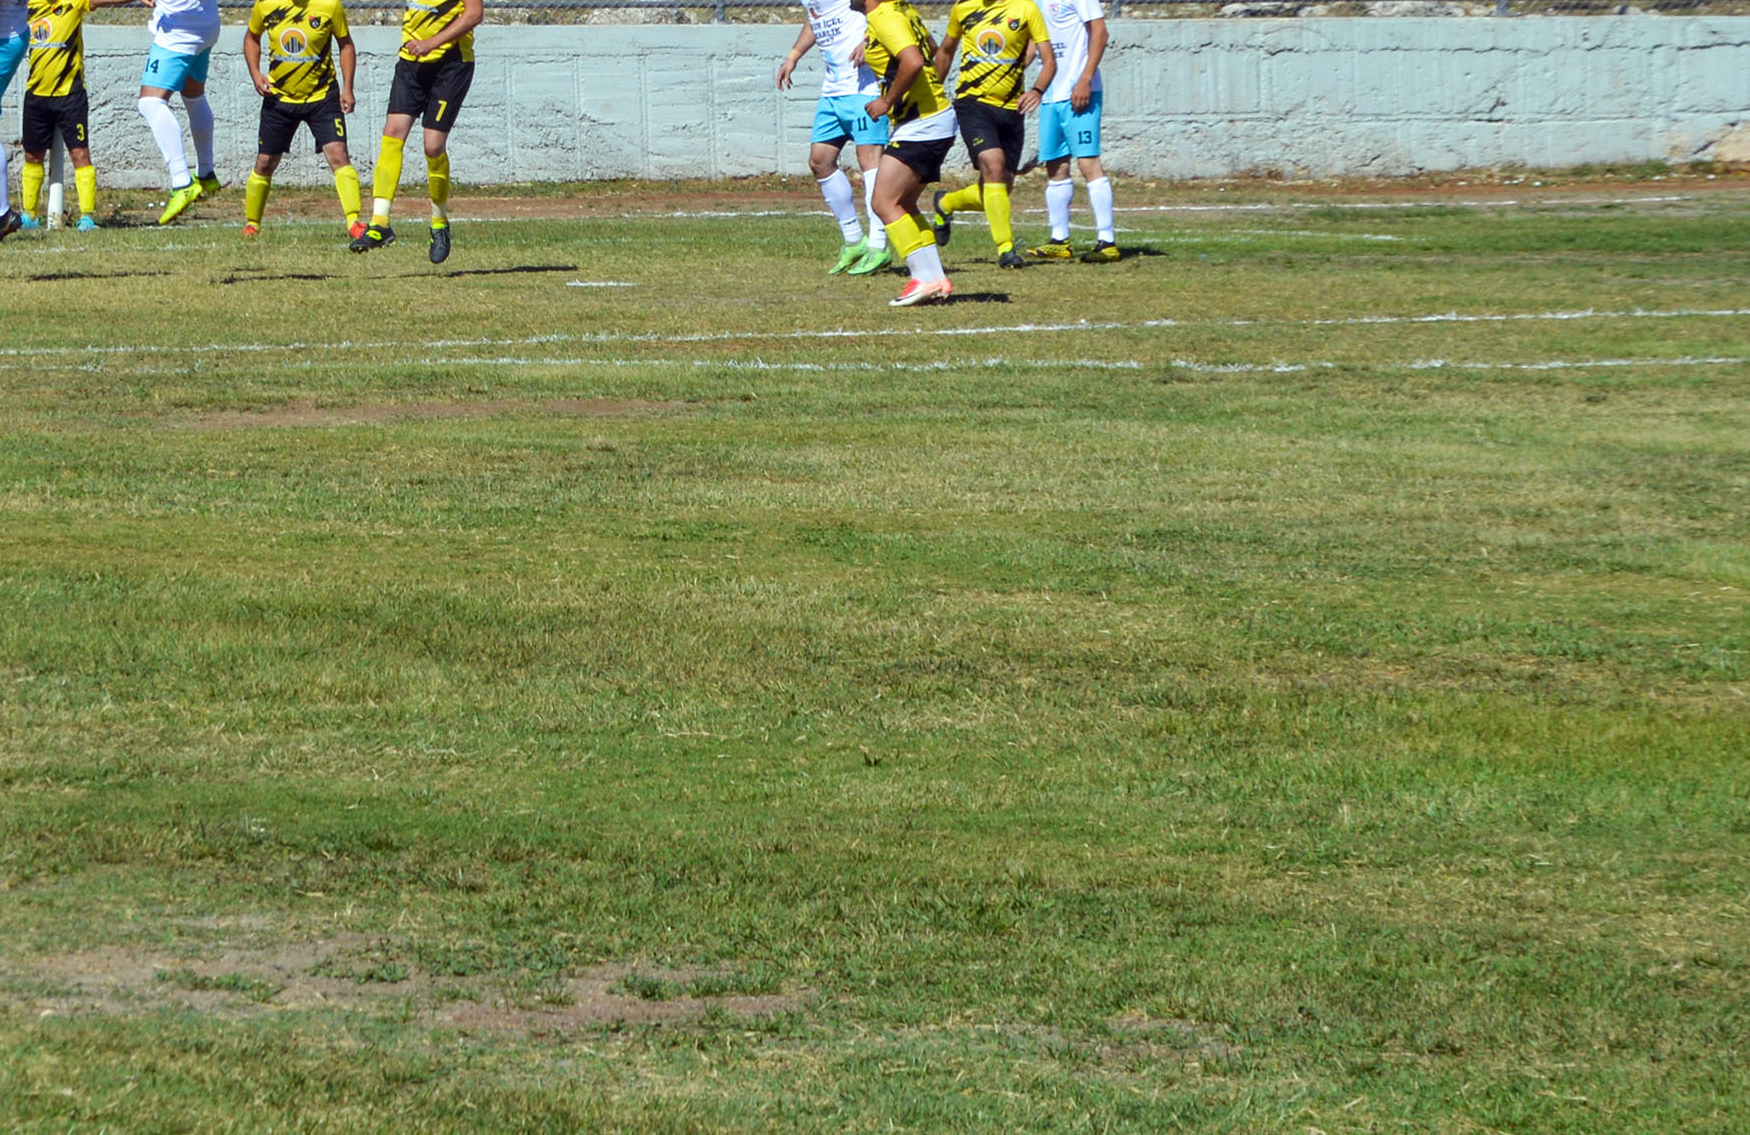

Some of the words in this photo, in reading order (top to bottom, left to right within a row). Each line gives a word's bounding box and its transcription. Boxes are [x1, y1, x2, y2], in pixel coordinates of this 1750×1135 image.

[145, 58, 160, 73] 14
[435, 100, 448, 122] 7
[334, 118, 345, 137] 5
[857, 116, 868, 131] 11
[76, 123, 85, 142] 3
[1078, 130, 1092, 144] 13
